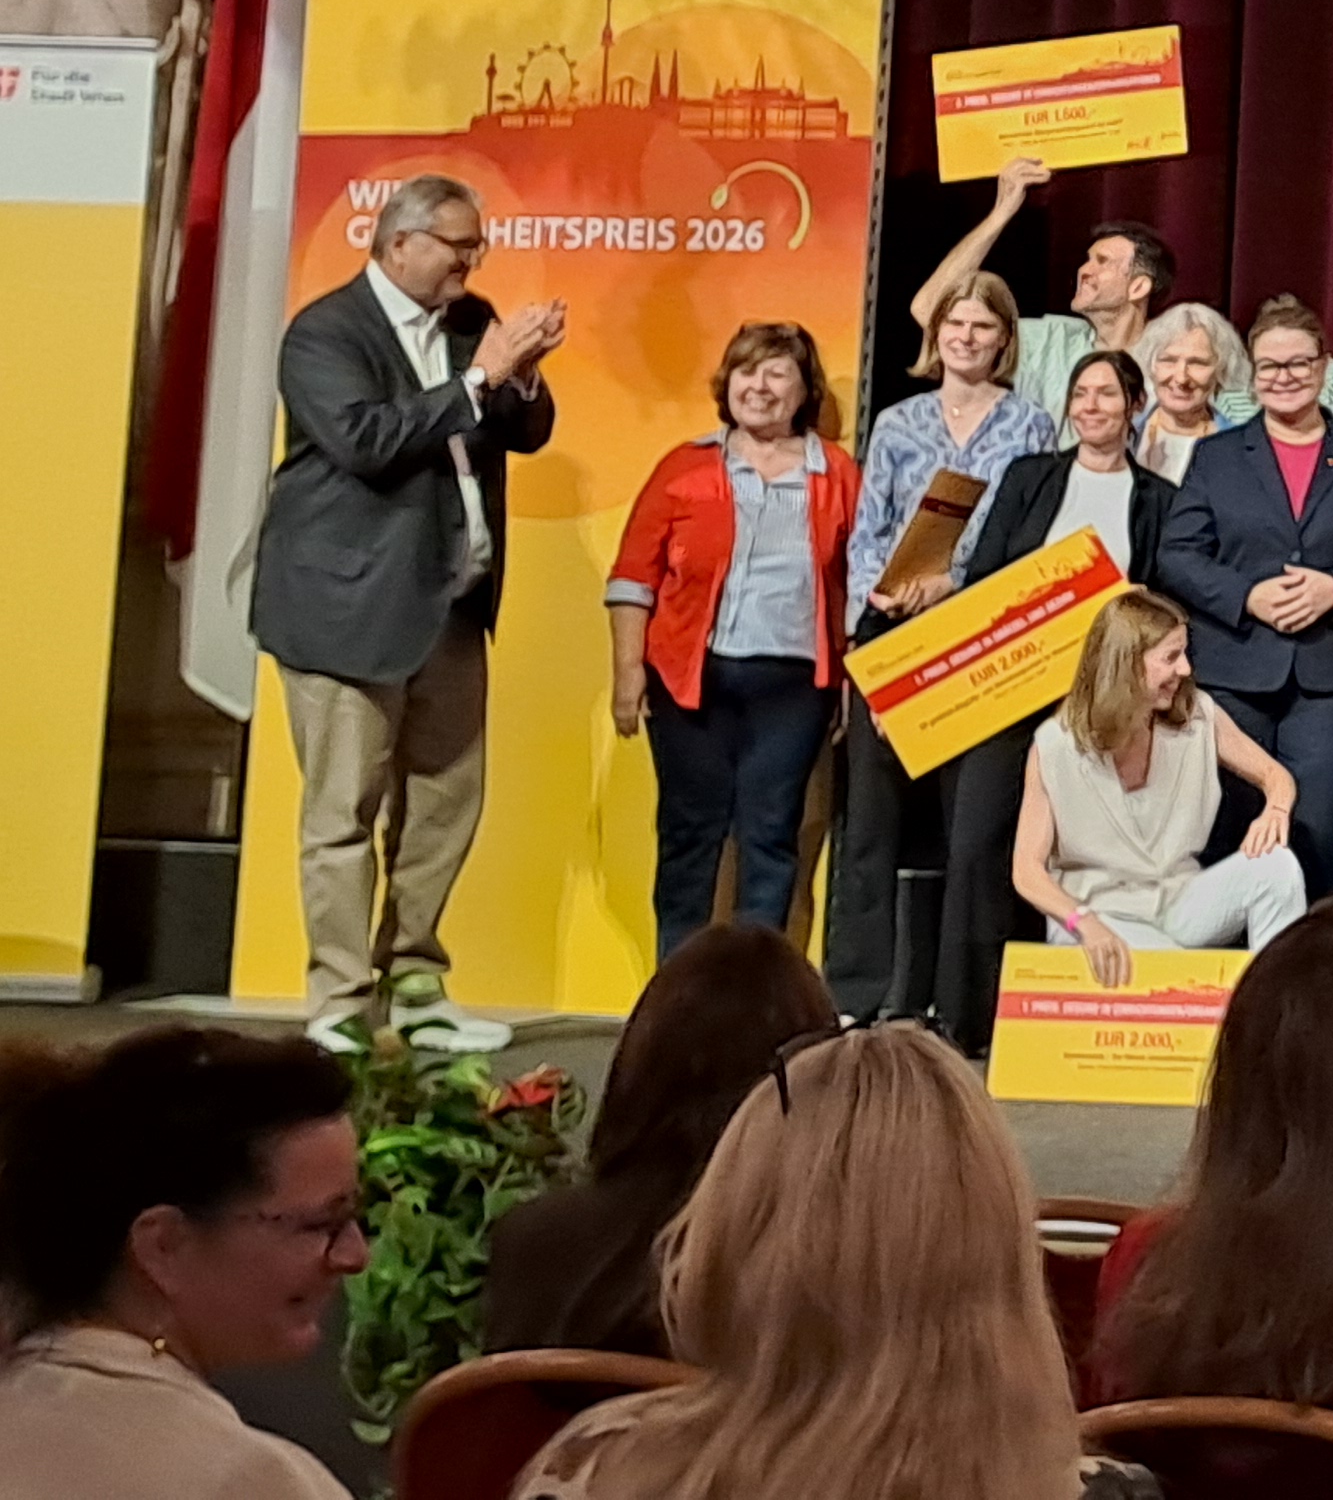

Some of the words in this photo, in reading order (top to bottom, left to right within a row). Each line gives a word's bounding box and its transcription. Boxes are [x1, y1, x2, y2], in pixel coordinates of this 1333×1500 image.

[346, 214, 676, 252] GHEITSPREIS
[686, 218, 766, 252] 2026
[1094, 1030, 1125, 1048] EUR
